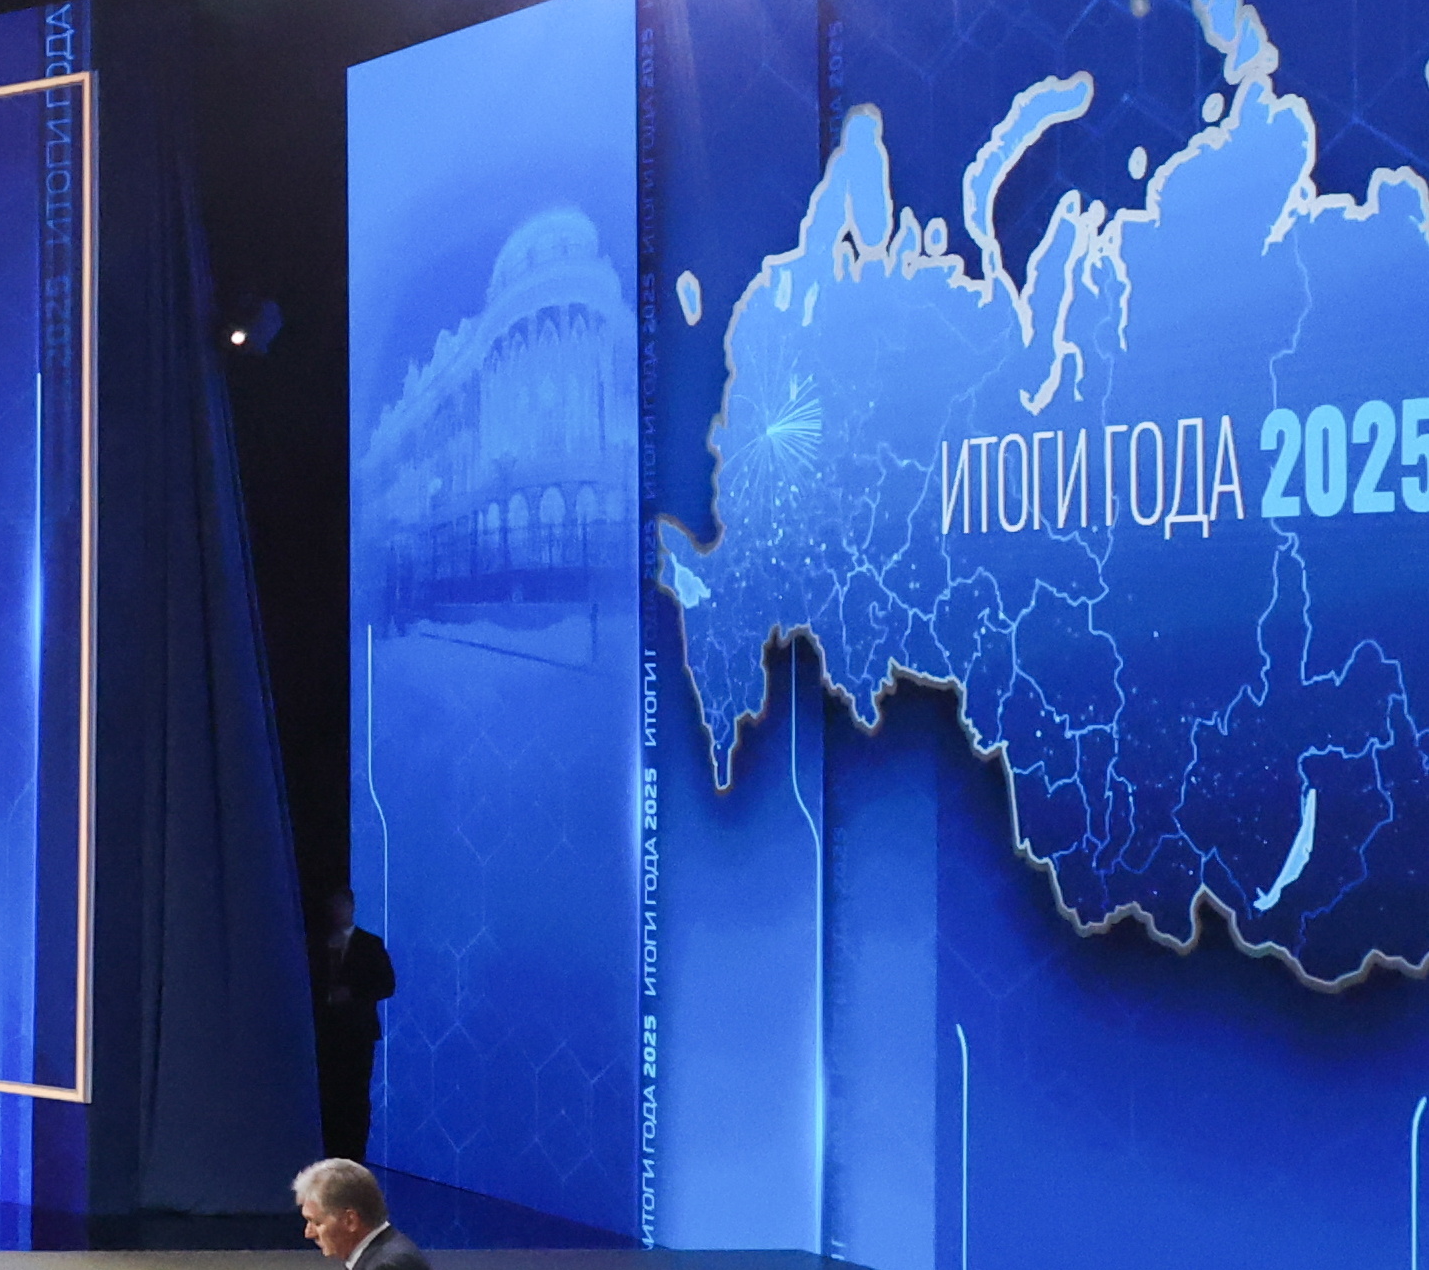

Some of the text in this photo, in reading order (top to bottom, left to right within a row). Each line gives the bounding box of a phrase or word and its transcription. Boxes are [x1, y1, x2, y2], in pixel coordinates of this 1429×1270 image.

[45, 117, 72, 244] ИТОГИ
[642, 271, 658, 334] 2025
[941, 397, 1429, 539] ИТОГИ ГОДА 2025
[642, 518, 658, 580] 2025
[642, 662, 658, 747] ИТОГИ
[642, 768, 660, 997] ИТОГИ ГОДА 2025
[642, 1015, 660, 1248] ИТОГИ ГОДА 2025
